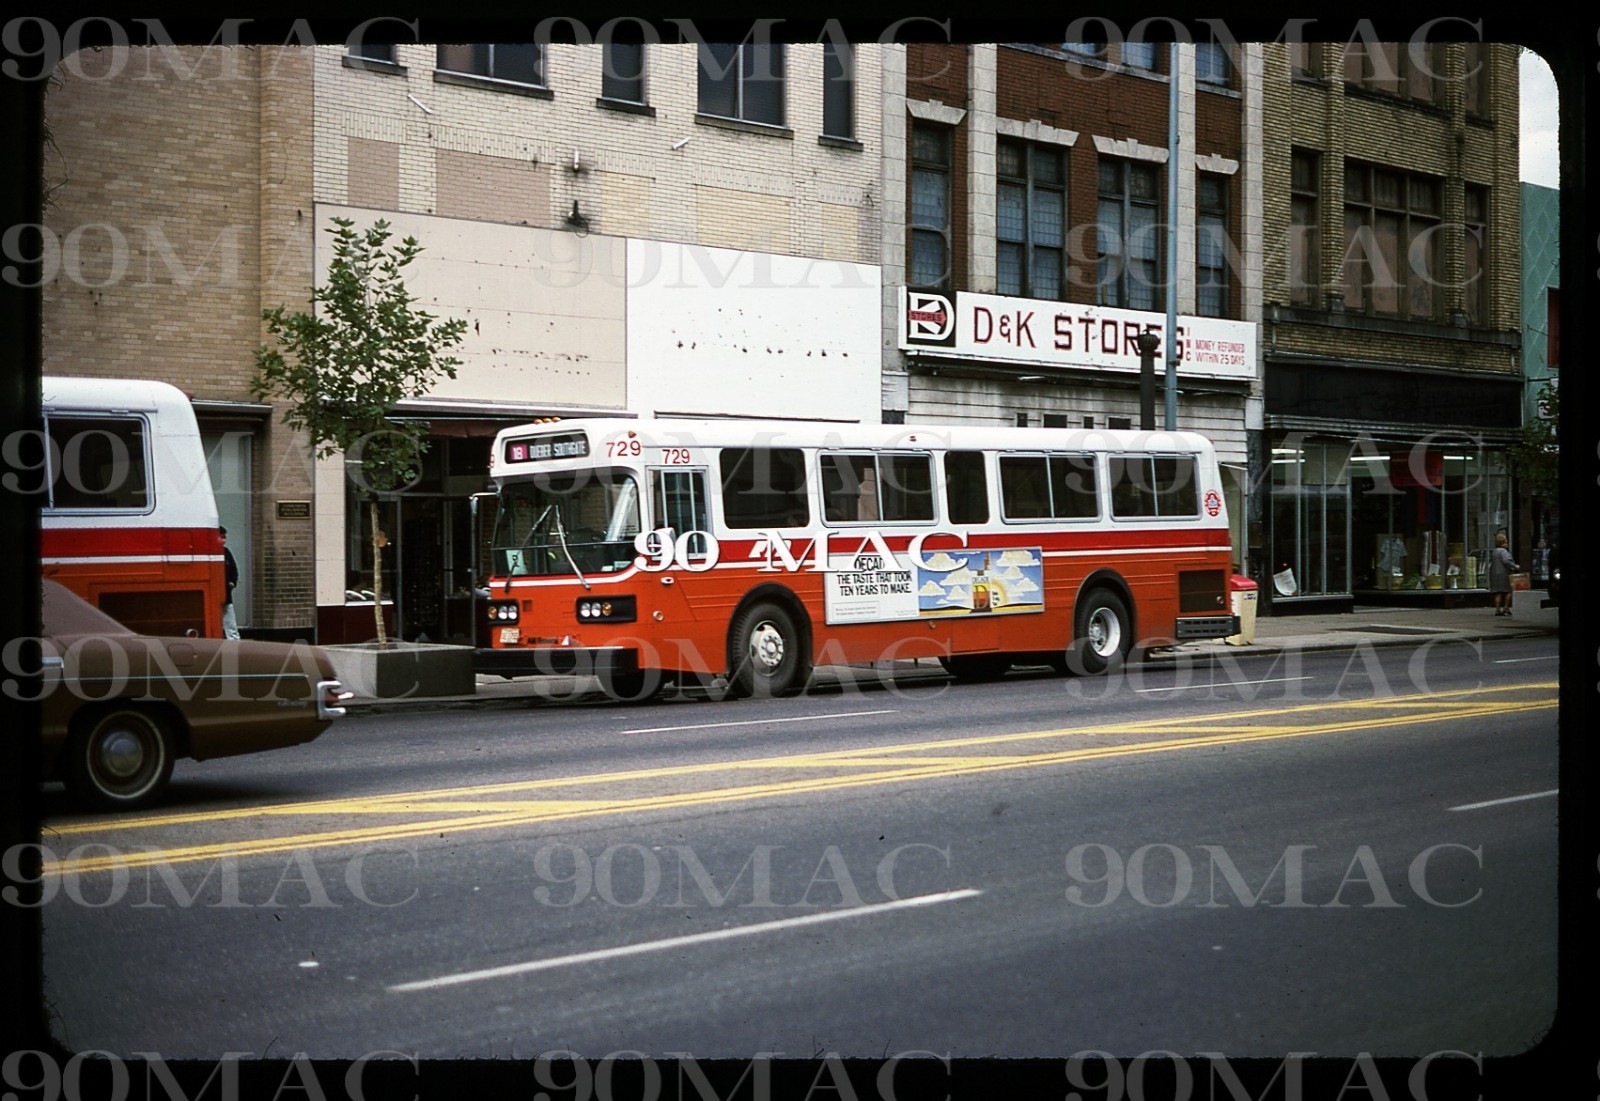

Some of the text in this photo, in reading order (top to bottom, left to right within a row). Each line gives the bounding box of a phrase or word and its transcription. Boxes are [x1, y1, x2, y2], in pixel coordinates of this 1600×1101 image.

[911, 311, 941, 322] STORES
[1196, 339, 1245, 353] MONEY REFUNDED
[1196, 352, 1218, 363] WITHIN
[1231, 354, 1245, 366] DAYS
[554, 441, 586, 456] SOUTHGATE
[606, 440, 642, 458] 729
[662, 449, 690, 464] 729
[854, 557, 886, 572] DECAD
[837, 571, 912, 585] THE TASTE THAT TOOK
[840, 585, 854, 596] TEN
[855, 584, 879, 596] YEARS
[880, 584, 889, 595] TO
